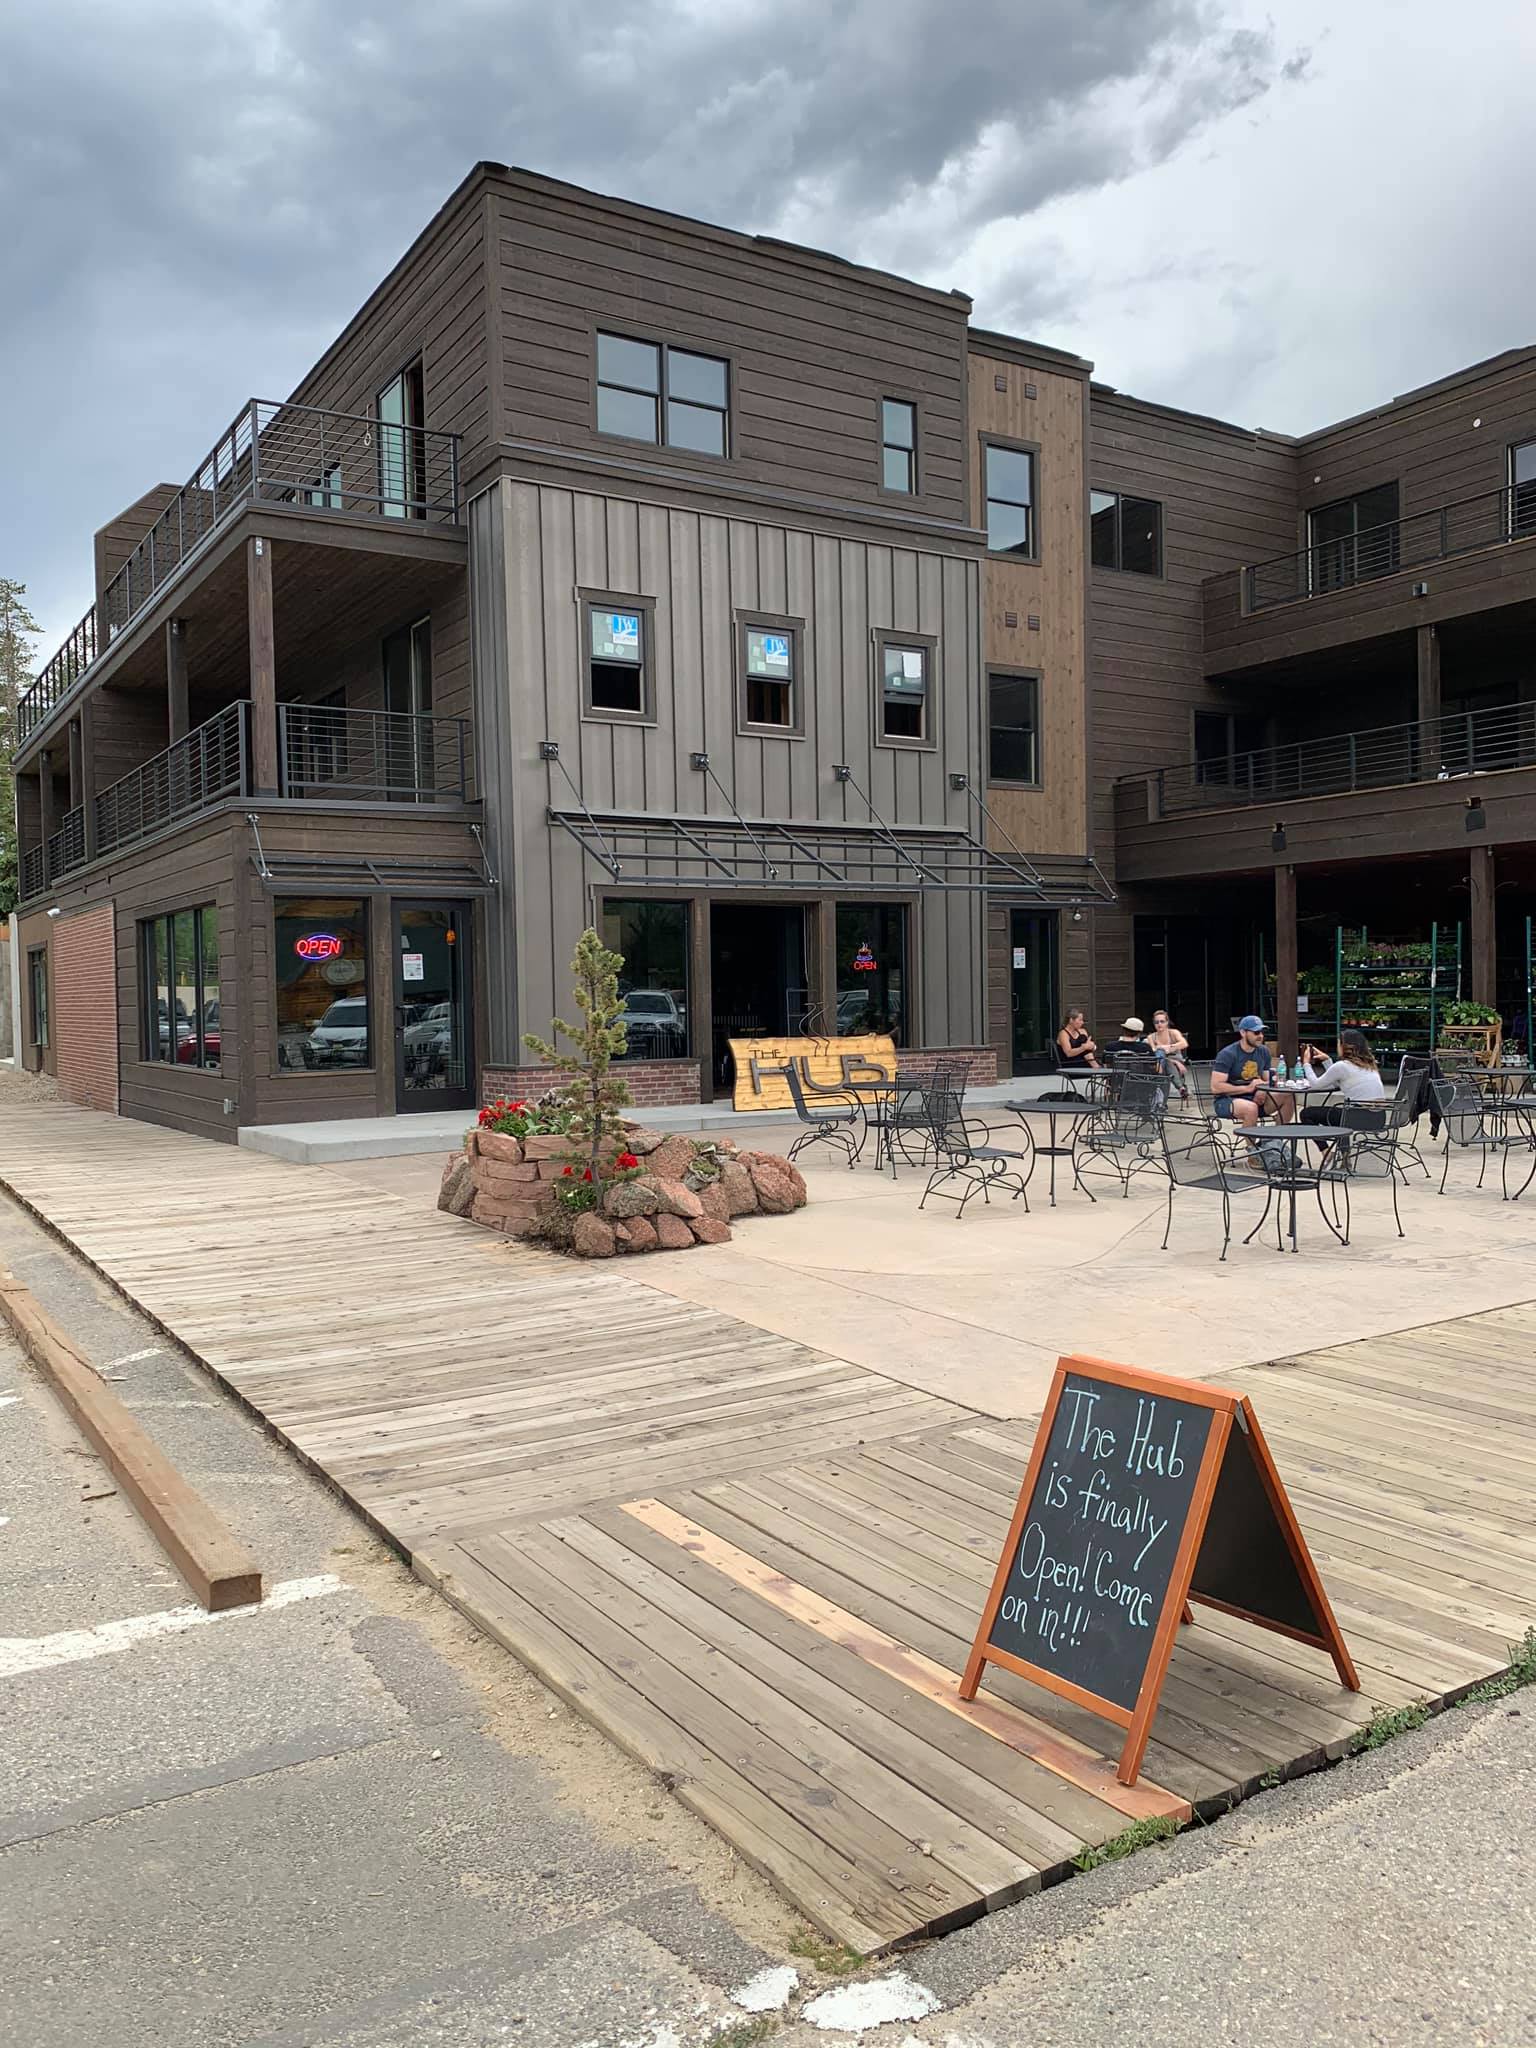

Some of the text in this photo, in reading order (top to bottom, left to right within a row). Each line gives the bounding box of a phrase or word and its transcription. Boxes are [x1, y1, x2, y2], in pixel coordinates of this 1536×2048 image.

[296, 939, 341, 955] OPEN
[853, 961, 877, 971] OPEN
[749, 1049, 786, 1059] THE
[750, 1055, 889, 1095] HUB
[1064, 1387, 1184, 1477] The Hub
[1045, 1461, 1168, 1571] is finally
[1094, 1550, 1154, 1627] Come
[1001, 1595, 1090, 1652] on in!!!
